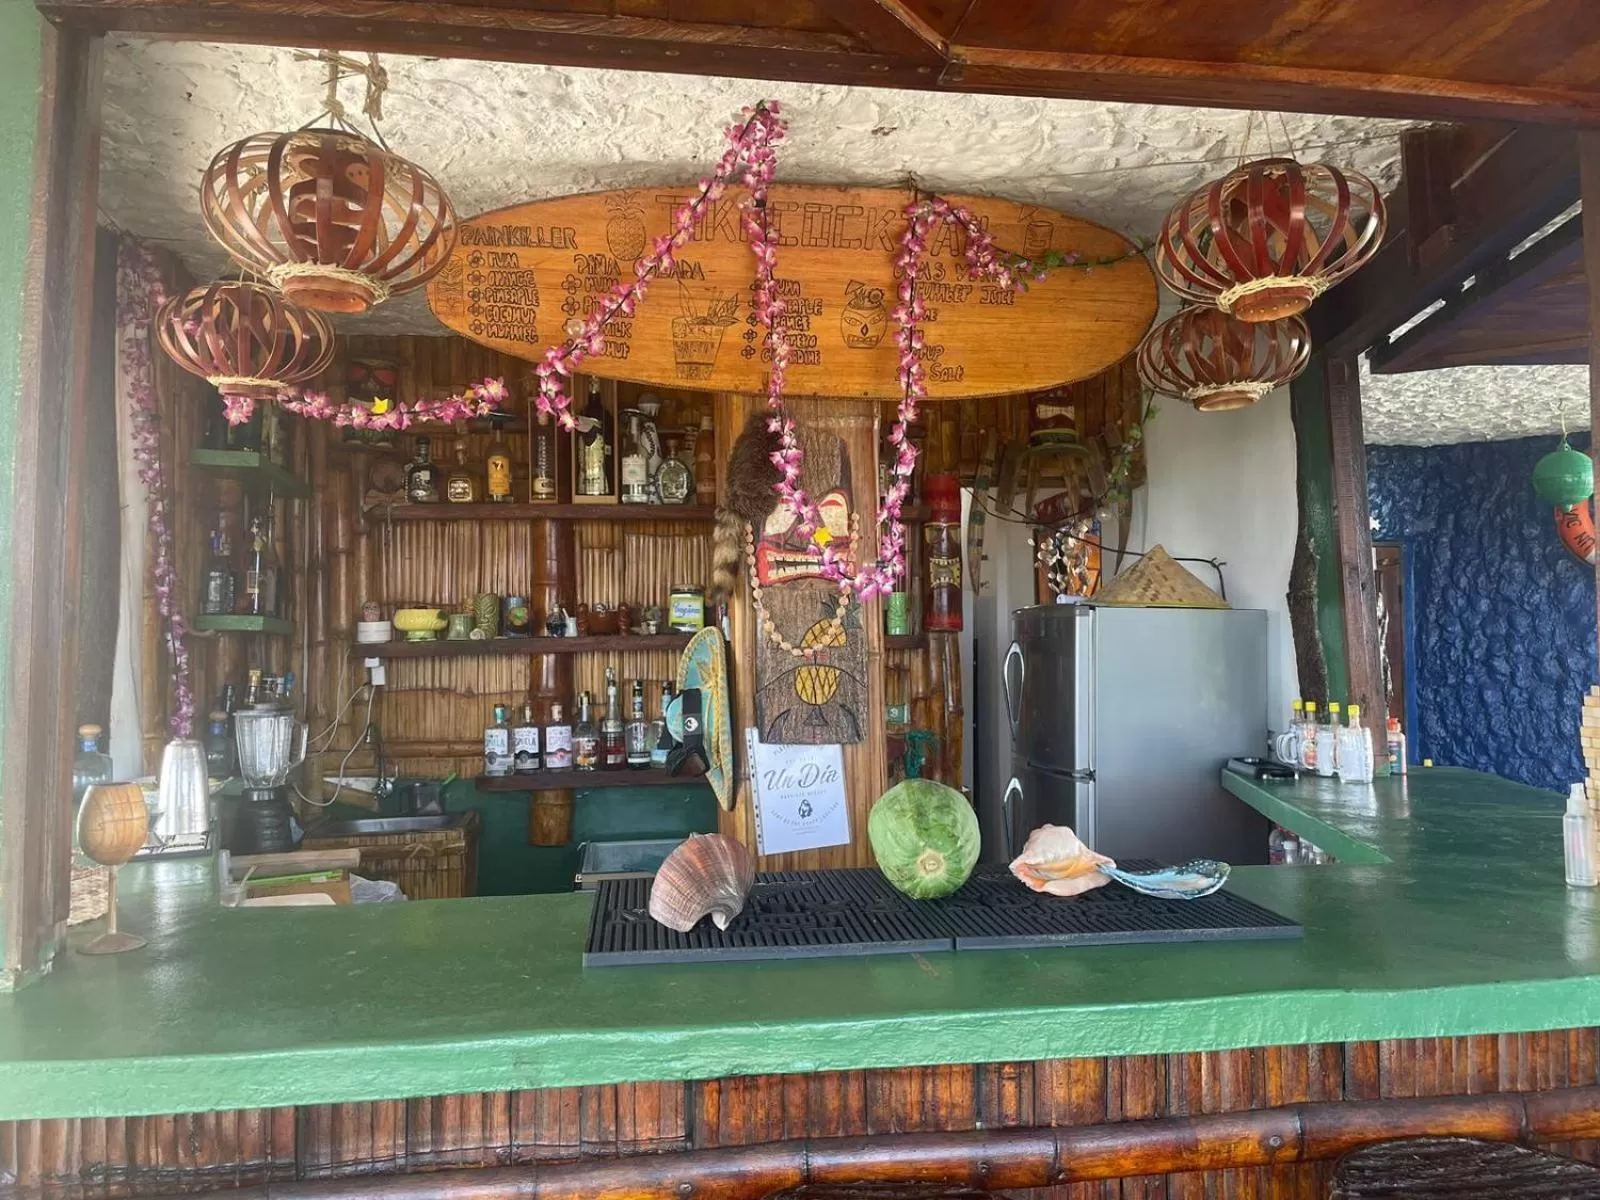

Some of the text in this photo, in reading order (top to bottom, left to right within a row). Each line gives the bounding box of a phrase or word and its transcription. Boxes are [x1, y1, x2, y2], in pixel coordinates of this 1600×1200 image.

[461, 224, 578, 250] PAINKILLER
[488, 252, 519, 269] RUM
[487, 269, 537, 288] ORANGE
[772, 315, 811, 332] RANGE
[763, 768, 796, 791] Un
